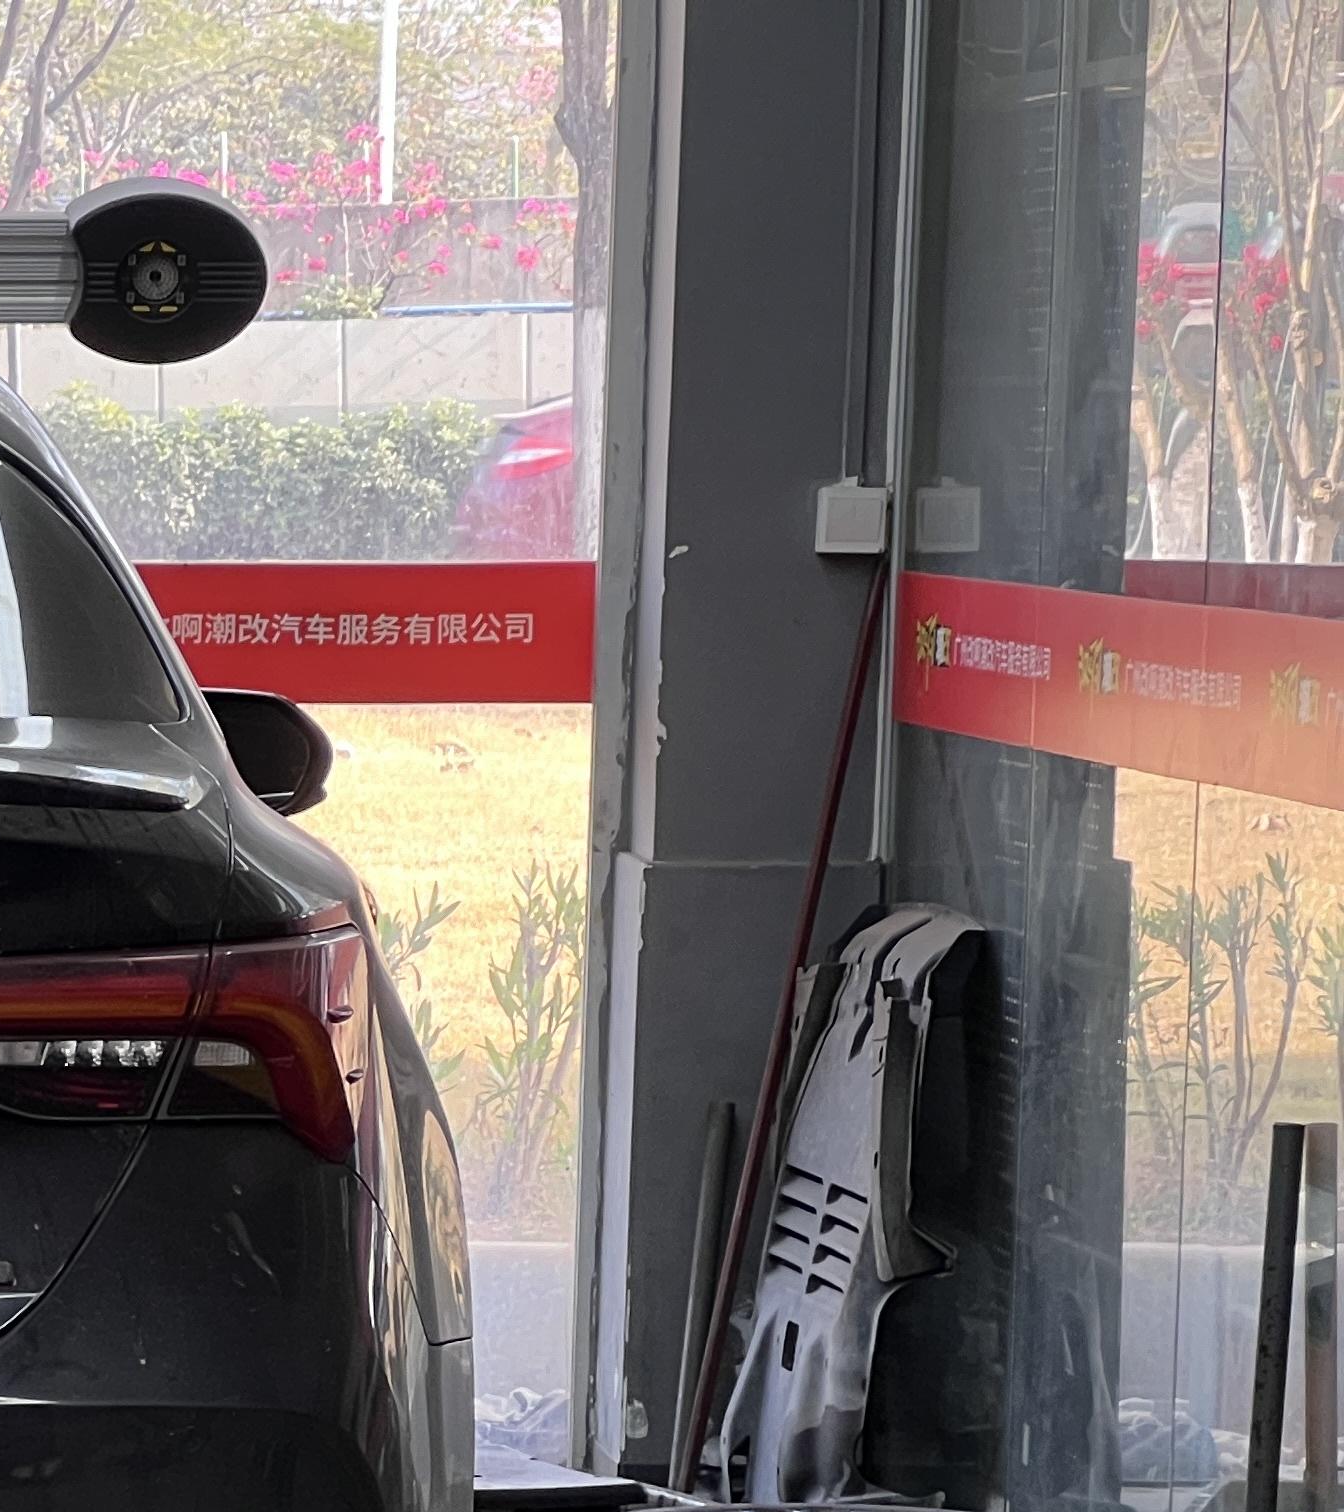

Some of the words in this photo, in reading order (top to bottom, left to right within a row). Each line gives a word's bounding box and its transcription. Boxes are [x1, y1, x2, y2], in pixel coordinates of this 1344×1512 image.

[162, 612, 535, 645] 啊潮改汽车服务有限公司
